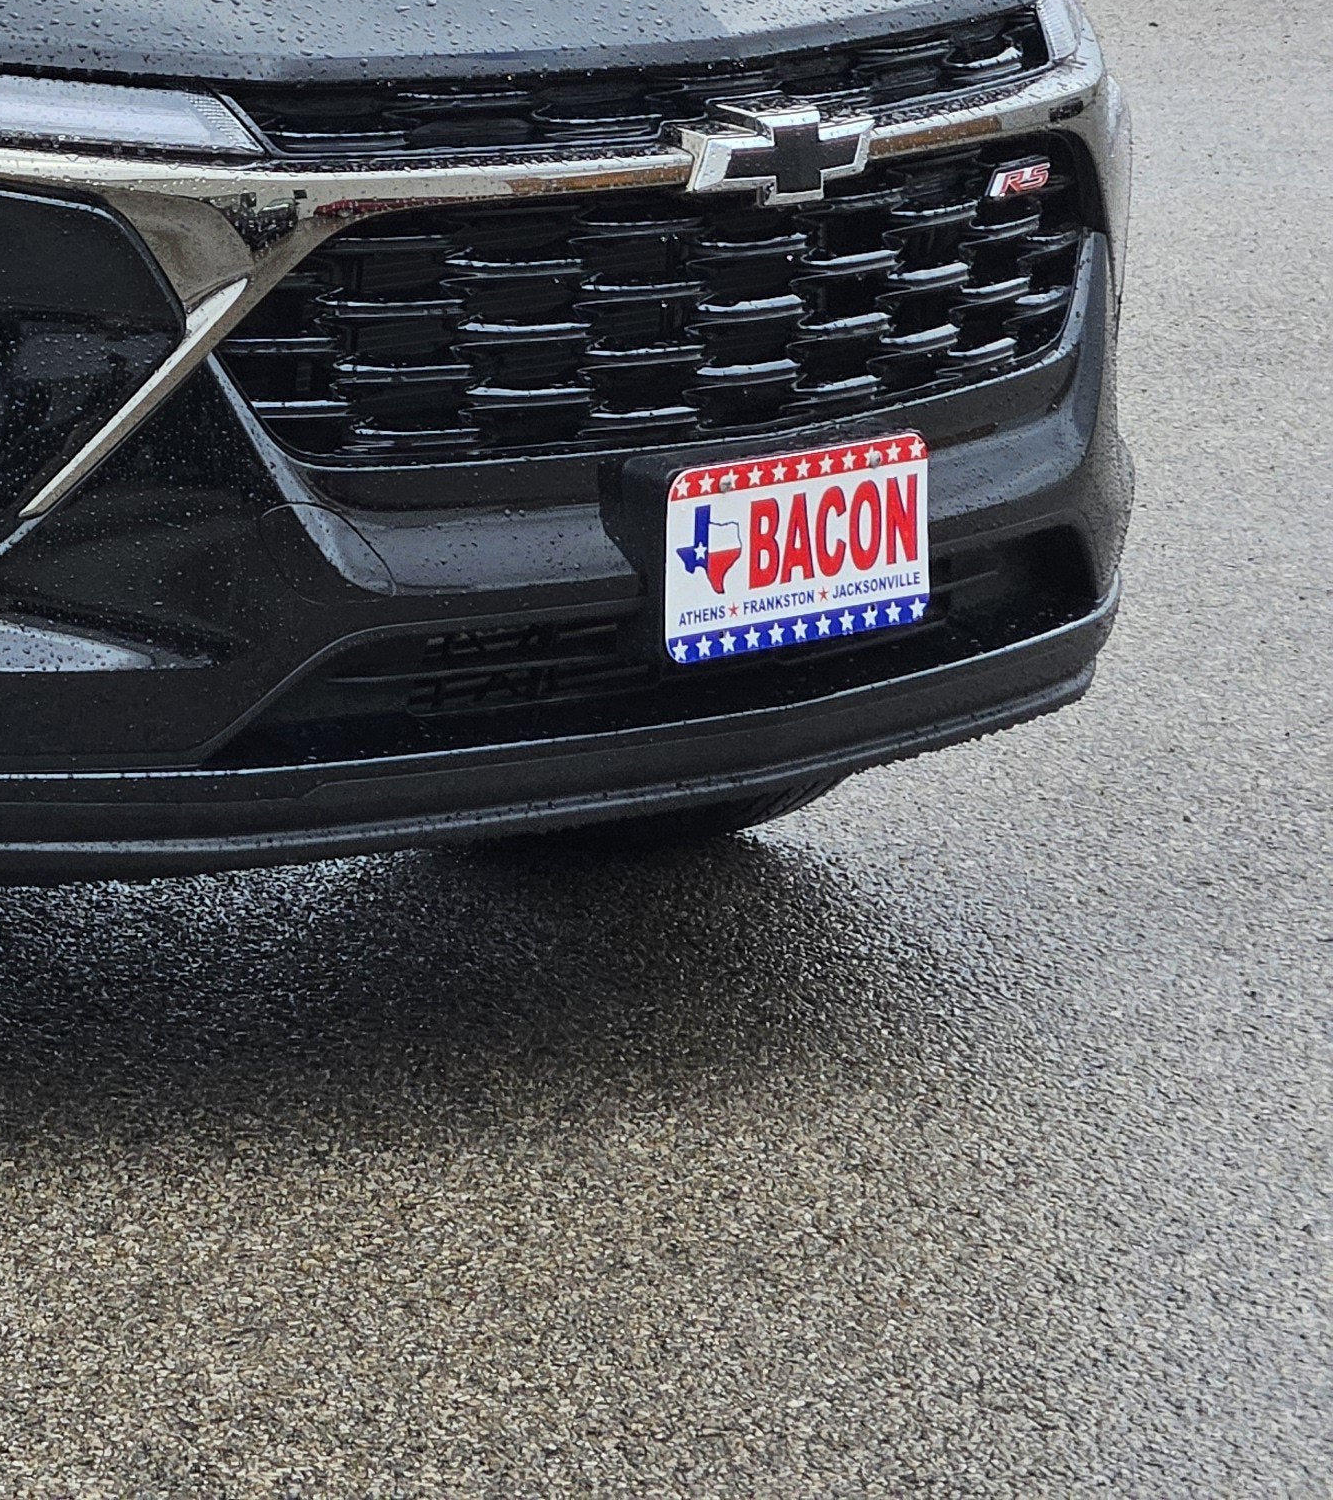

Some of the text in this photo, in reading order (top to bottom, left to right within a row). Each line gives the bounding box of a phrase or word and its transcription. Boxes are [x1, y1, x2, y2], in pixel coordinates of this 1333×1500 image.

[989, 162, 1051, 197] RS
[748, 473, 919, 590] BACON
[678, 571, 921, 627] ATHENS FRANKSTON JACKSONVILLE
